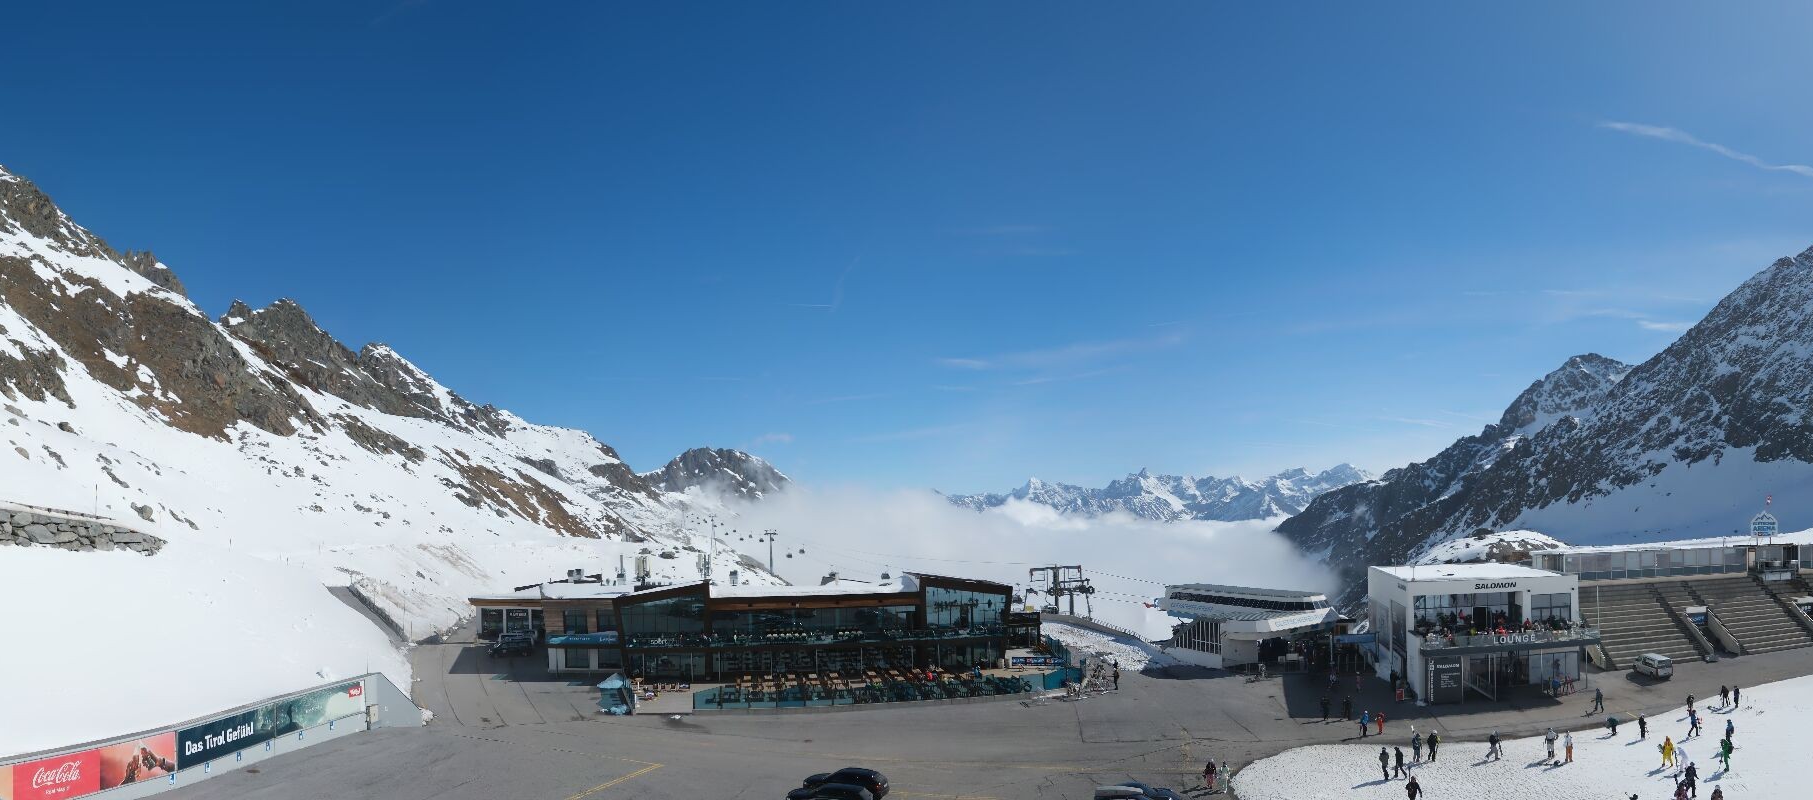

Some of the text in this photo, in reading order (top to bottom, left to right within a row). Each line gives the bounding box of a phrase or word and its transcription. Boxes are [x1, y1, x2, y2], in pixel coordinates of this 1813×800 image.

[1474, 581, 1517, 590] SALOMON
[1493, 634, 1536, 645] LOUNGE
[185, 721, 254, 756] Das Tirol Gefühl
